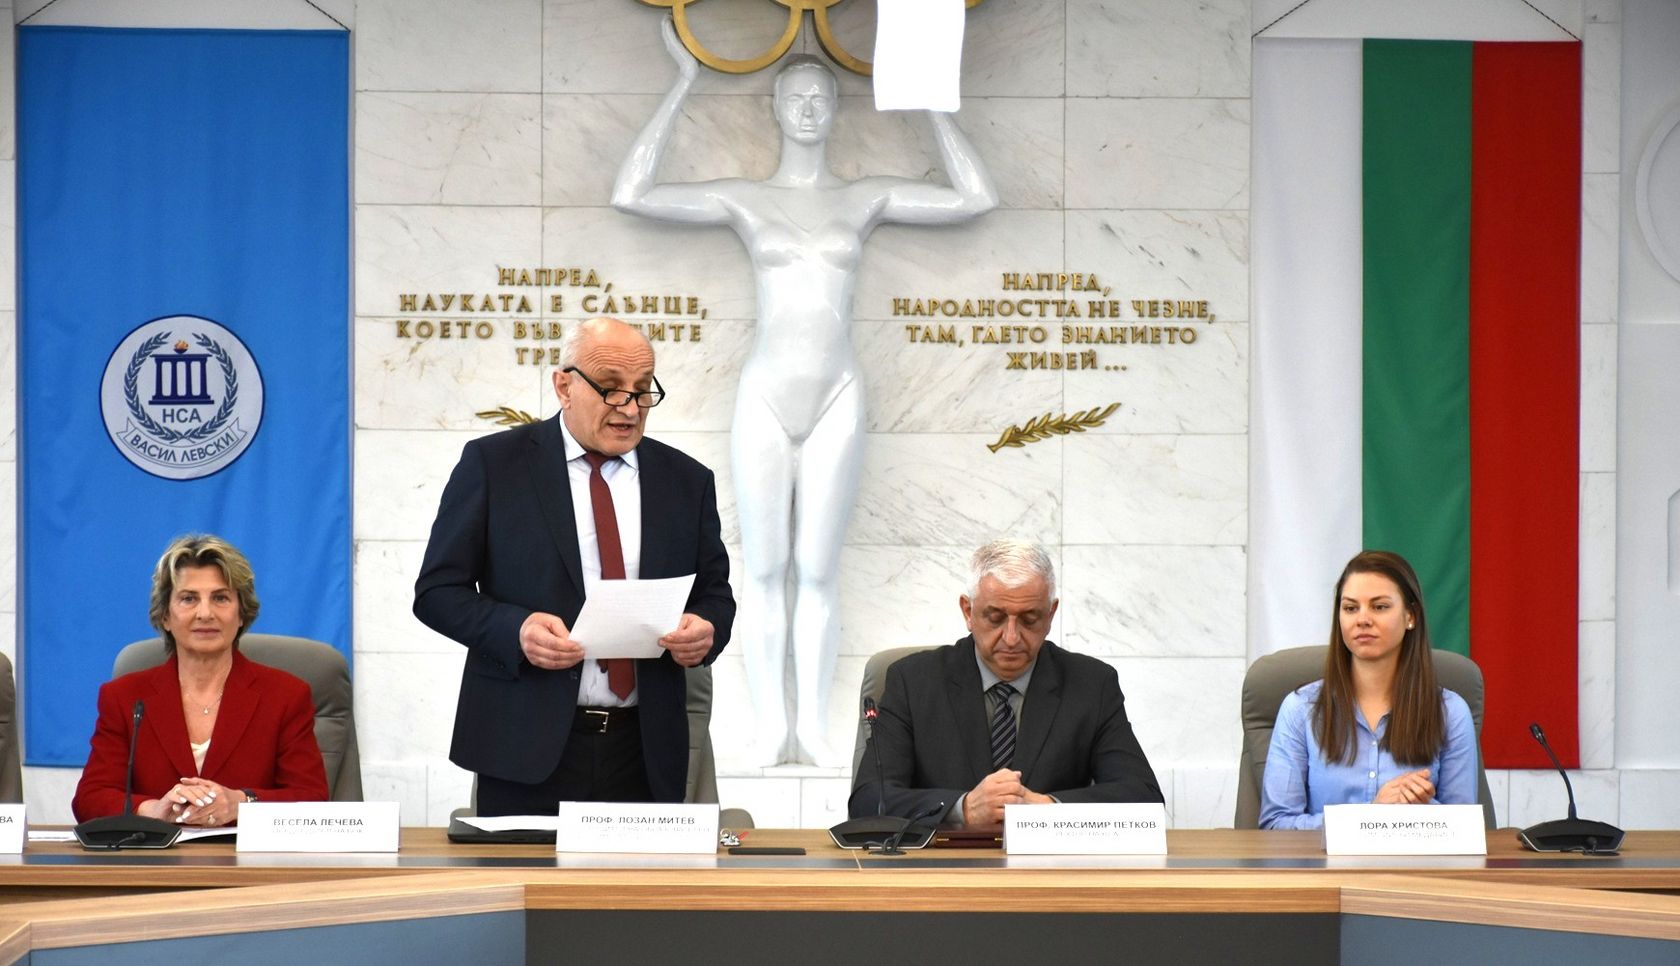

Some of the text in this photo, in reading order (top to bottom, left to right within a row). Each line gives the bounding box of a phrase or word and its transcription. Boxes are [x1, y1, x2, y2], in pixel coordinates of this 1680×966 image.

[498, 267, 613, 292] НАПРЕД,
[1002, 272, 1112, 297] НАПРЕД,
[399, 294, 708, 319] НАУКАТА Е СЛЪНЦЕ,
[893, 297, 1216, 324] НАРОДНОСТТА НЕ ЧЕЗНЕ,
[396, 319, 494, 339] КОЕТО
[513, 321, 562, 340] ВЪВ
[905, 324, 1198, 348] ТАМ, ГДЕТО ЗНАНИЕТО
[1005, 350, 1098, 371] ЖИВЕЙ
[162, 408, 202, 423] НСА
[130, 432, 235, 463] ВАСИЛ ЛЕВСКИ
[657, 816, 695, 825] МИТЕВ
[1053, 821, 1111, 830] КРАСИМИР
[1113, 821, 1157, 830] ПЕТКОВ
[1359, 821, 1448, 831] ЛОРА ХРИСТОВА
